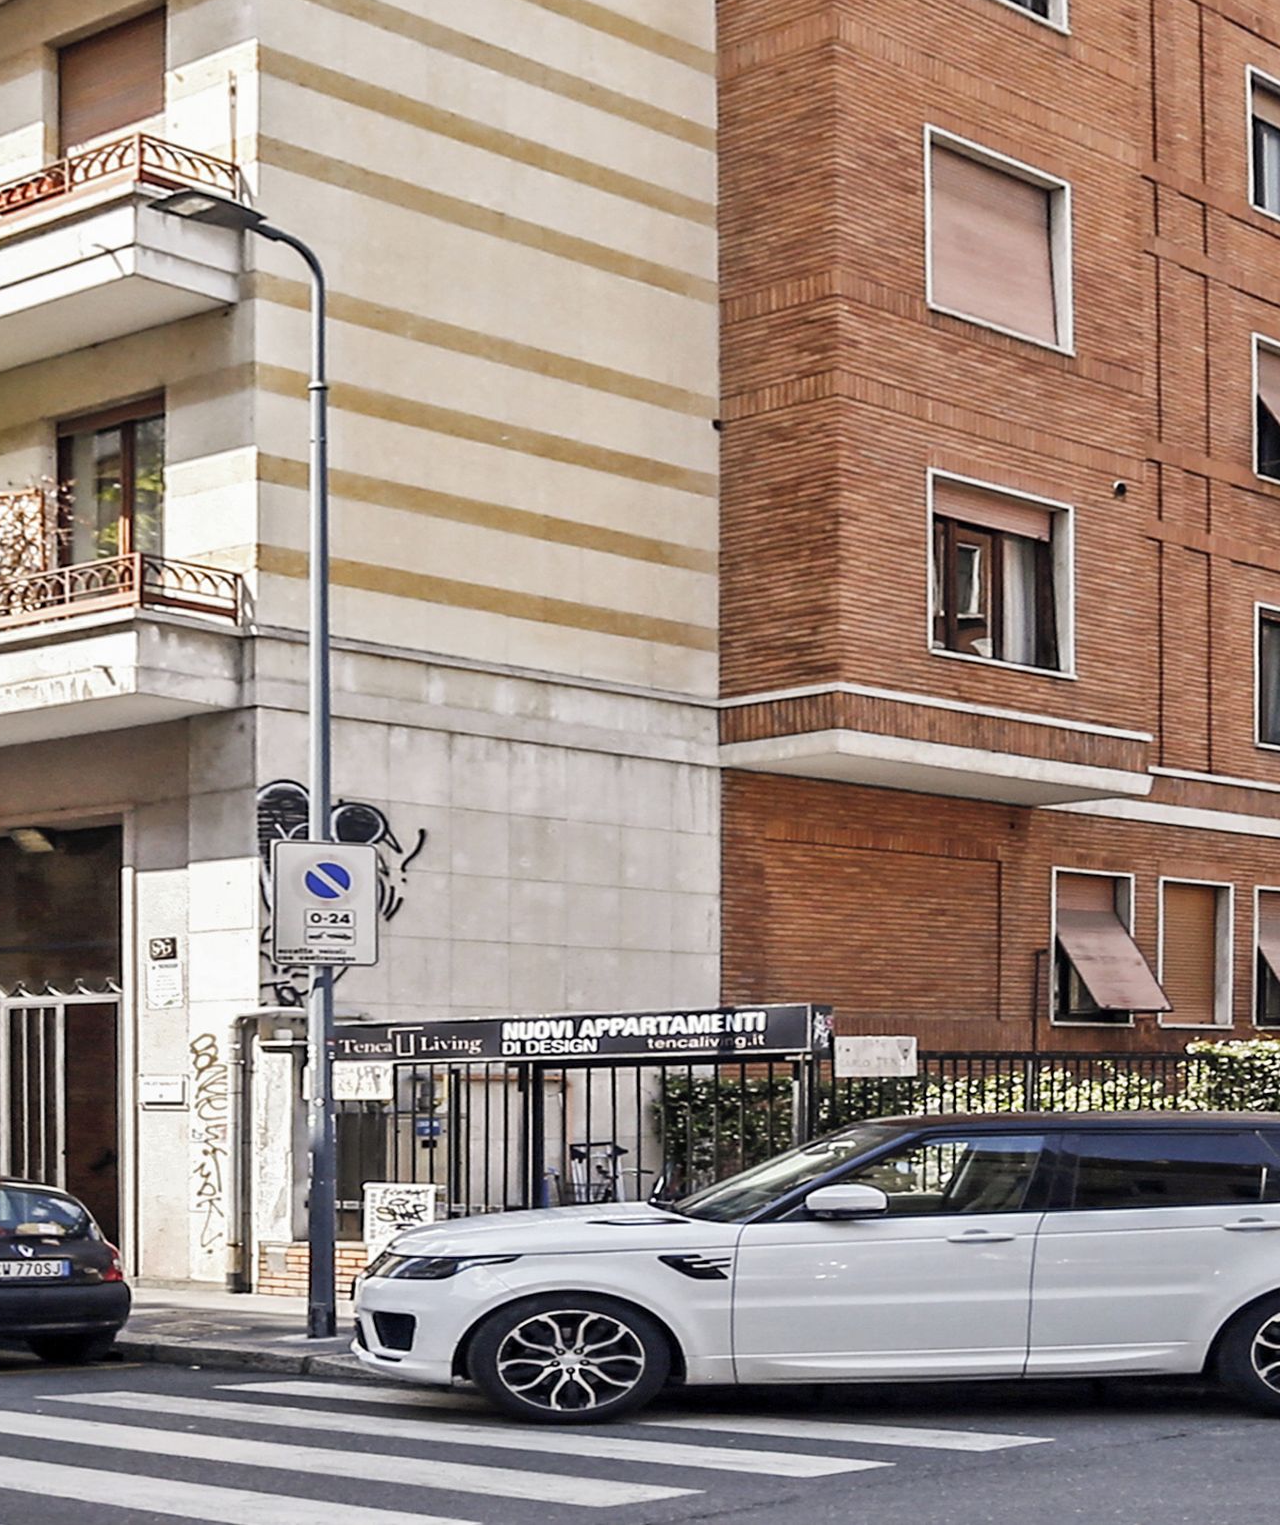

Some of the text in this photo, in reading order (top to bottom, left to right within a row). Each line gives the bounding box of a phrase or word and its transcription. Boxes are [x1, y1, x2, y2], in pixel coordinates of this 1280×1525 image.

[502, 1011, 767, 1041] NUOVI APPARTAMENTI
[338, 1038, 393, 1054] Tenca
[420, 1036, 483, 1054] Living
[502, 1038, 598, 1055] DI DESIGN
